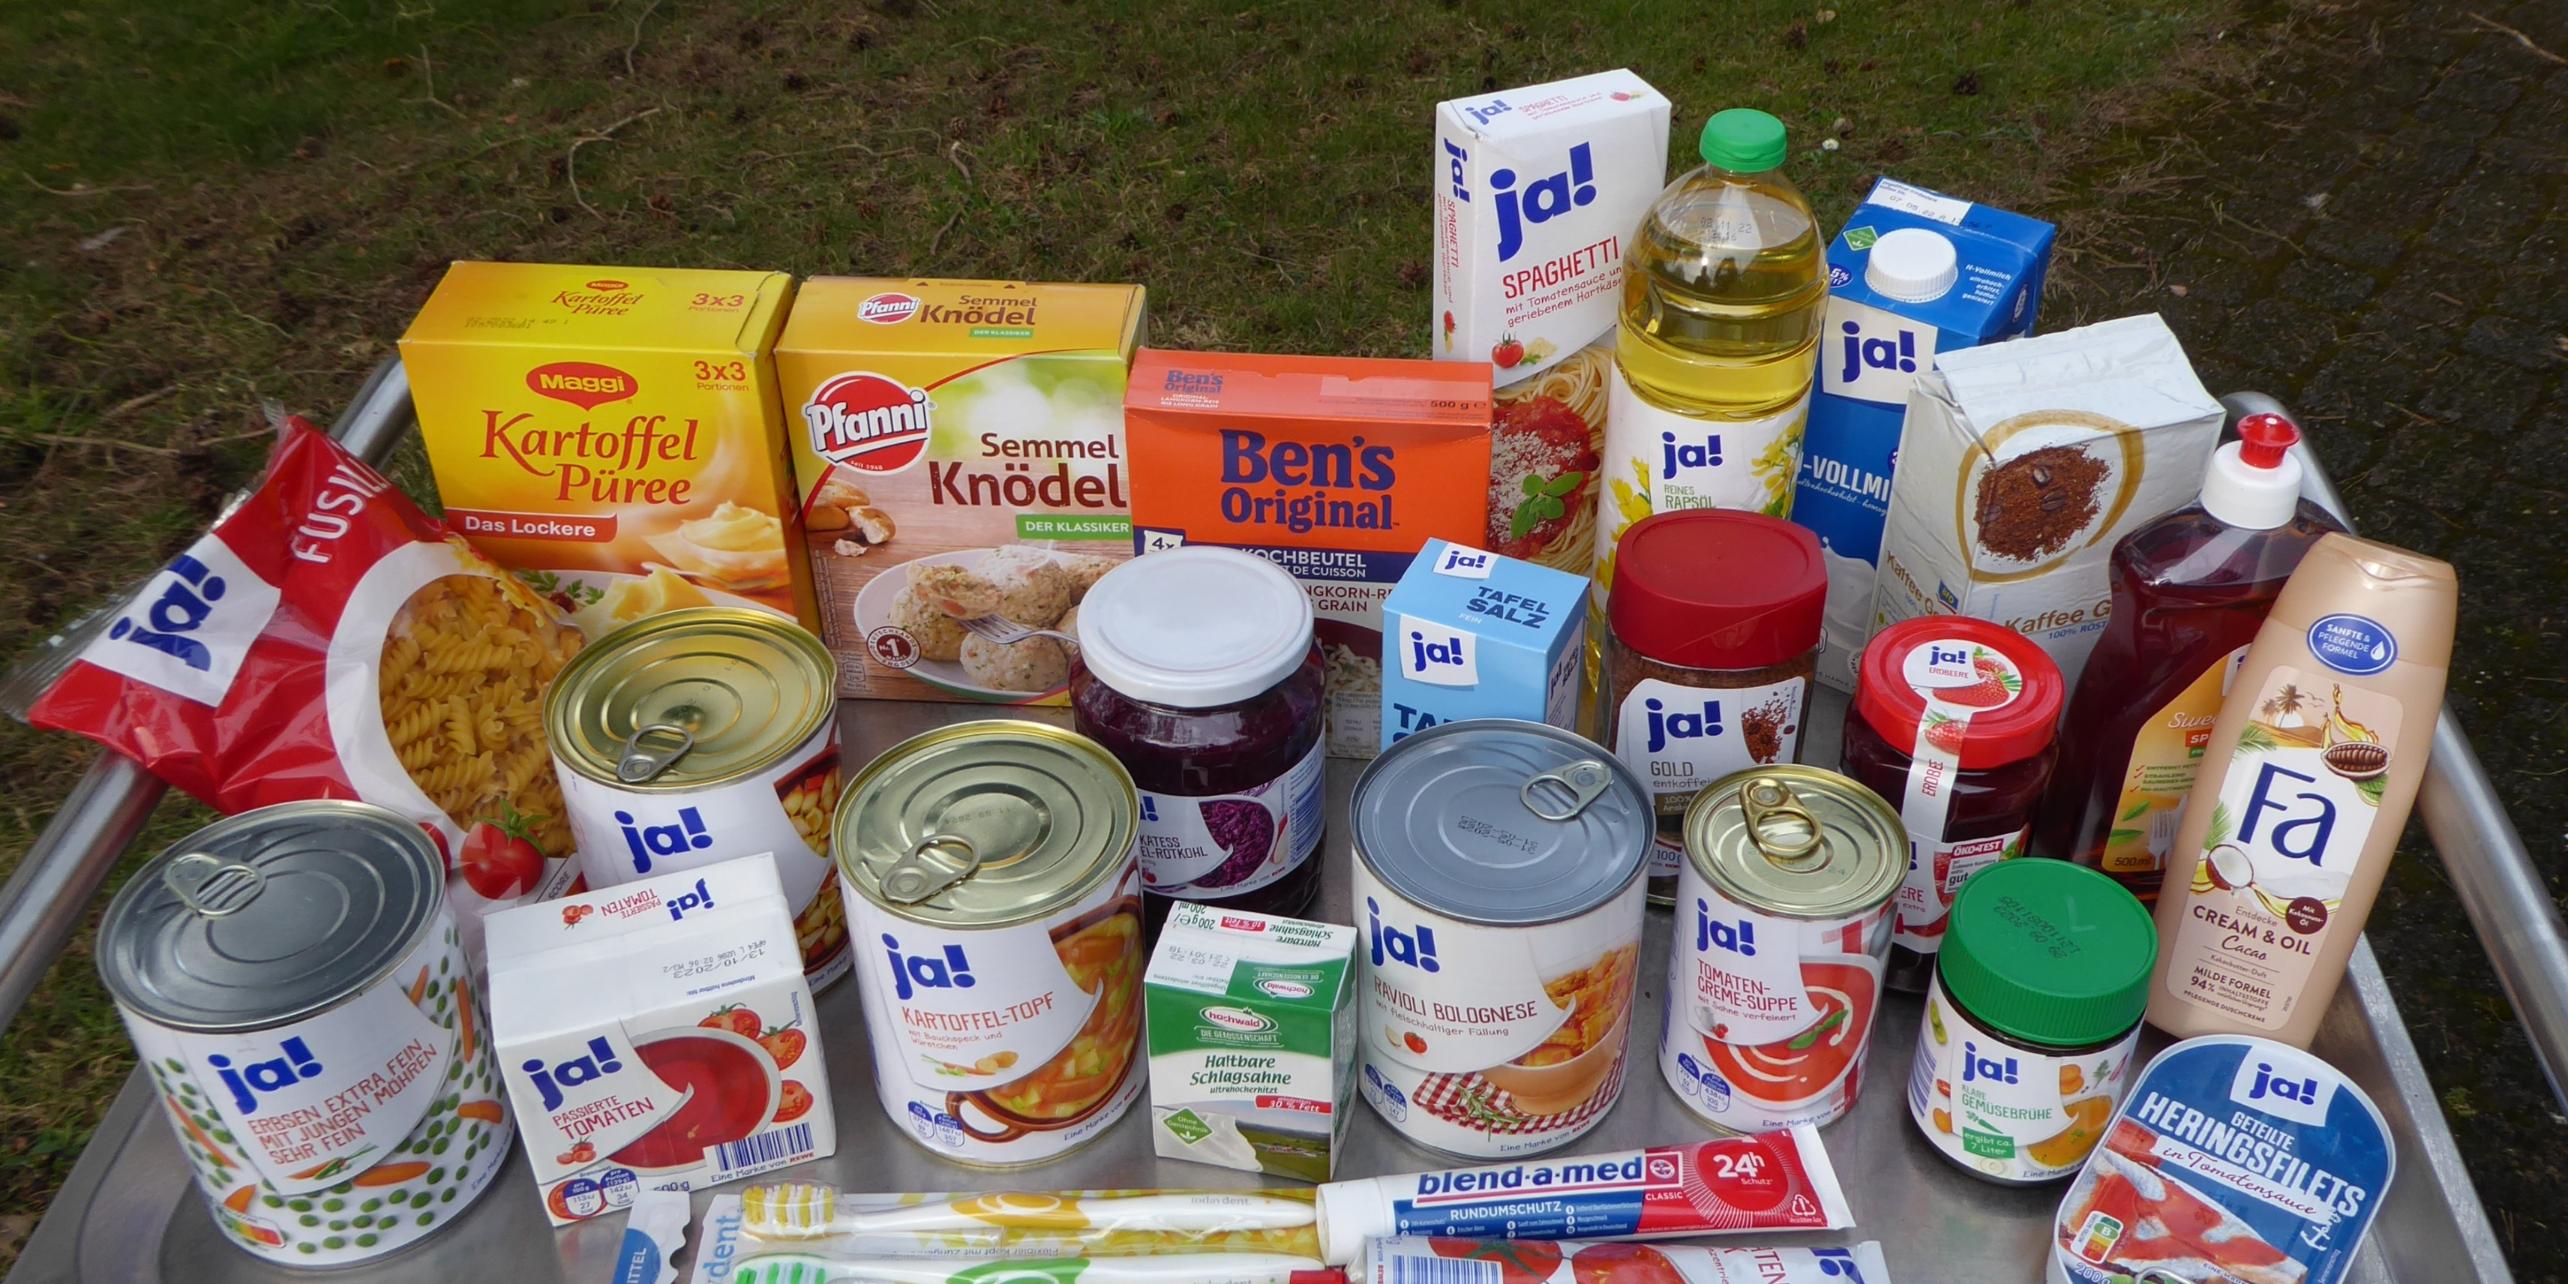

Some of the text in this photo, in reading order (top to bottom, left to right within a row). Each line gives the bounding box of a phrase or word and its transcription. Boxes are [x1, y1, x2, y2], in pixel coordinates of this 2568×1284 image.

[1465, 100, 1512, 125] ja!
[1444, 138, 1470, 203] ja!
[1490, 141, 1597, 262] ja!
[1503, 236, 1620, 300] SPAGHETTI
[551, 291, 644, 307] Kartoffel
[691, 293, 744, 307] 3x3
[959, 294, 1038, 307] Semmel
[1506, 267, 1622, 314] mit Tomatensauce un
[572, 303, 629, 317] Püree
[859, 300, 918, 320] Pfanni
[920, 303, 1036, 326] Knödel
[1508, 298, 1573, 328] geriebenem
[1842, 320, 1916, 383] ja!
[694, 360, 746, 381] 3x3
[1168, 370, 1223, 384] Ben's
[539, 372, 626, 393] Maggi
[696, 381, 749, 392] Portionen
[1164, 383, 1221, 393] Original
[806, 390, 927, 451] Pfanni
[479, 409, 699, 477] Kartoffel
[981, 433, 1119, 459] Semmel
[1219, 429, 1396, 491] Ben's
[1662, 432, 1723, 479] ja!
[554, 463, 692, 505] Püree
[929, 460, 1127, 508] Knödel
[1799, 451, 1890, 502] -VOLLMI
[1664, 484, 1695, 495] REINES
[1221, 487, 1393, 534] Original
[465, 515, 596, 537] Das Lockere
[1025, 521, 1129, 533] DER KLASSIKER
[1445, 550, 1487, 570] ja!
[1293, 566, 1310, 575] DE
[1312, 567, 1366, 578] CUISSON
[1304, 585, 1393, 600] NGKORN-R
[1478, 586, 1550, 614] TAFEL
[109, 554, 226, 672] ja!
[1319, 600, 1368, 612] GRAIN
[1466, 598, 1547, 629] SALZ
[1458, 612, 1483, 624] FEIN
[2004, 607, 2085, 635] Kaffee
[2048, 627, 2077, 640] 100%
[2319, 632, 2369, 652] PFLEGENDE
[2327, 624, 2364, 640] SANFTE
[1411, 630, 1463, 672] ja!
[1929, 646, 1967, 665] ja!
[2322, 643, 2358, 659] FORMEL
[1928, 667, 1969, 678] ERDBEERE
[1645, 698, 1724, 752] ja!
[1650, 760, 1694, 778] GOLD
[2236, 762, 2336, 867] Fa
[614, 806, 713, 874] ja!
[1140, 835, 1180, 848] KATESS
[1140, 846, 1207, 860] EL-ROTKOHL
[1657, 850, 1675, 860] 100
[1949, 872, 1968, 886] gut
[601, 888, 658, 918] TOMATEN
[621, 898, 662, 919] PASSIERTE
[666, 878, 715, 921] ja!
[1178, 902, 1188, 912] ml
[2303, 905, 2315, 913] Mit
[1198, 918, 1215, 929] 200
[1697, 898, 1756, 957] ja!
[2236, 906, 2278, 927] Entdecke
[1269, 924, 1334, 939] Schlagsahne
[1366, 895, 1441, 973] ja!
[2193, 905, 2311, 955] CREAM & OIL
[2222, 935, 2267, 960] Cacao
[881, 933, 976, 1000] ja!
[1697, 958, 1771, 995] TOMATEN-
[1266, 983, 1308, 994] hochwald
[2194, 966, 2271, 998] MILDE FORMEL
[1374, 975, 1538, 1023] RAVIOLI BOLOGNESE
[1697, 976, 1798, 1012] CREME-SUPPE
[902, 992, 1054, 1031] KARTOFFEL-TOPF
[1742, 1011, 1797, 1023] verfeinert
[2184, 990, 2219, 1008] PFLEGENDE
[2220, 1003, 2265, 1022] DUSCHCREME
[1209, 1011, 1260, 1028] hochwald
[1467, 1023, 1510, 1038] Füllung
[984, 1031, 1003, 1040] und
[1201, 1029, 1214, 1038] DIE
[1205, 1054, 1276, 1070] Haltbare
[1963, 1041, 2019, 1085] ja!
[208, 1035, 324, 1115] ja!
[522, 1036, 623, 1112] ja!
[1189, 1070, 1291, 1086] Schlagsahne
[2249, 1062, 2318, 1106] ja!
[247, 1039, 424, 1136] ERBSEN EXTRA FEIN
[1210, 1085, 1278, 1095] ultrahocherhitzt
[551, 1095, 621, 1127] PASSIERTE
[1269, 1100, 1282, 1108] 30
[1300, 1102, 1320, 1112] Fett
[1962, 1094, 2052, 1120] GEMÜSEBRÜHE
[258, 1129, 296, 1150] MIT
[300, 1102, 372, 1142] JUNGEN
[559, 1097, 655, 1140] TOMATEN
[1572, 1120, 1590, 1134] REWE
[1762, 1119, 1783, 1127] Eine
[1064, 1129, 1083, 1142] Eine
[1964, 1131, 2012, 1148] ergibt ca.
[2231, 1111, 2296, 1151] GETEILTE
[268, 1123, 366, 1165] SEHR FEIN
[1970, 1140, 2007, 1156] 7 Liter
[2137, 1091, 2367, 1218] HERINGSFILETS
[711, 1152, 814, 1183] Eine Marke von REWE
[1713, 1152, 1765, 1179] 24h
[2162, 1147, 2317, 1215] in Tomatensauce
[1646, 1191, 1683, 1200] CLASSIC
[1450, 1201, 1562, 1221] RUNDUMSCHUTZ
[2074, 1263, 2098, 1279] 200
